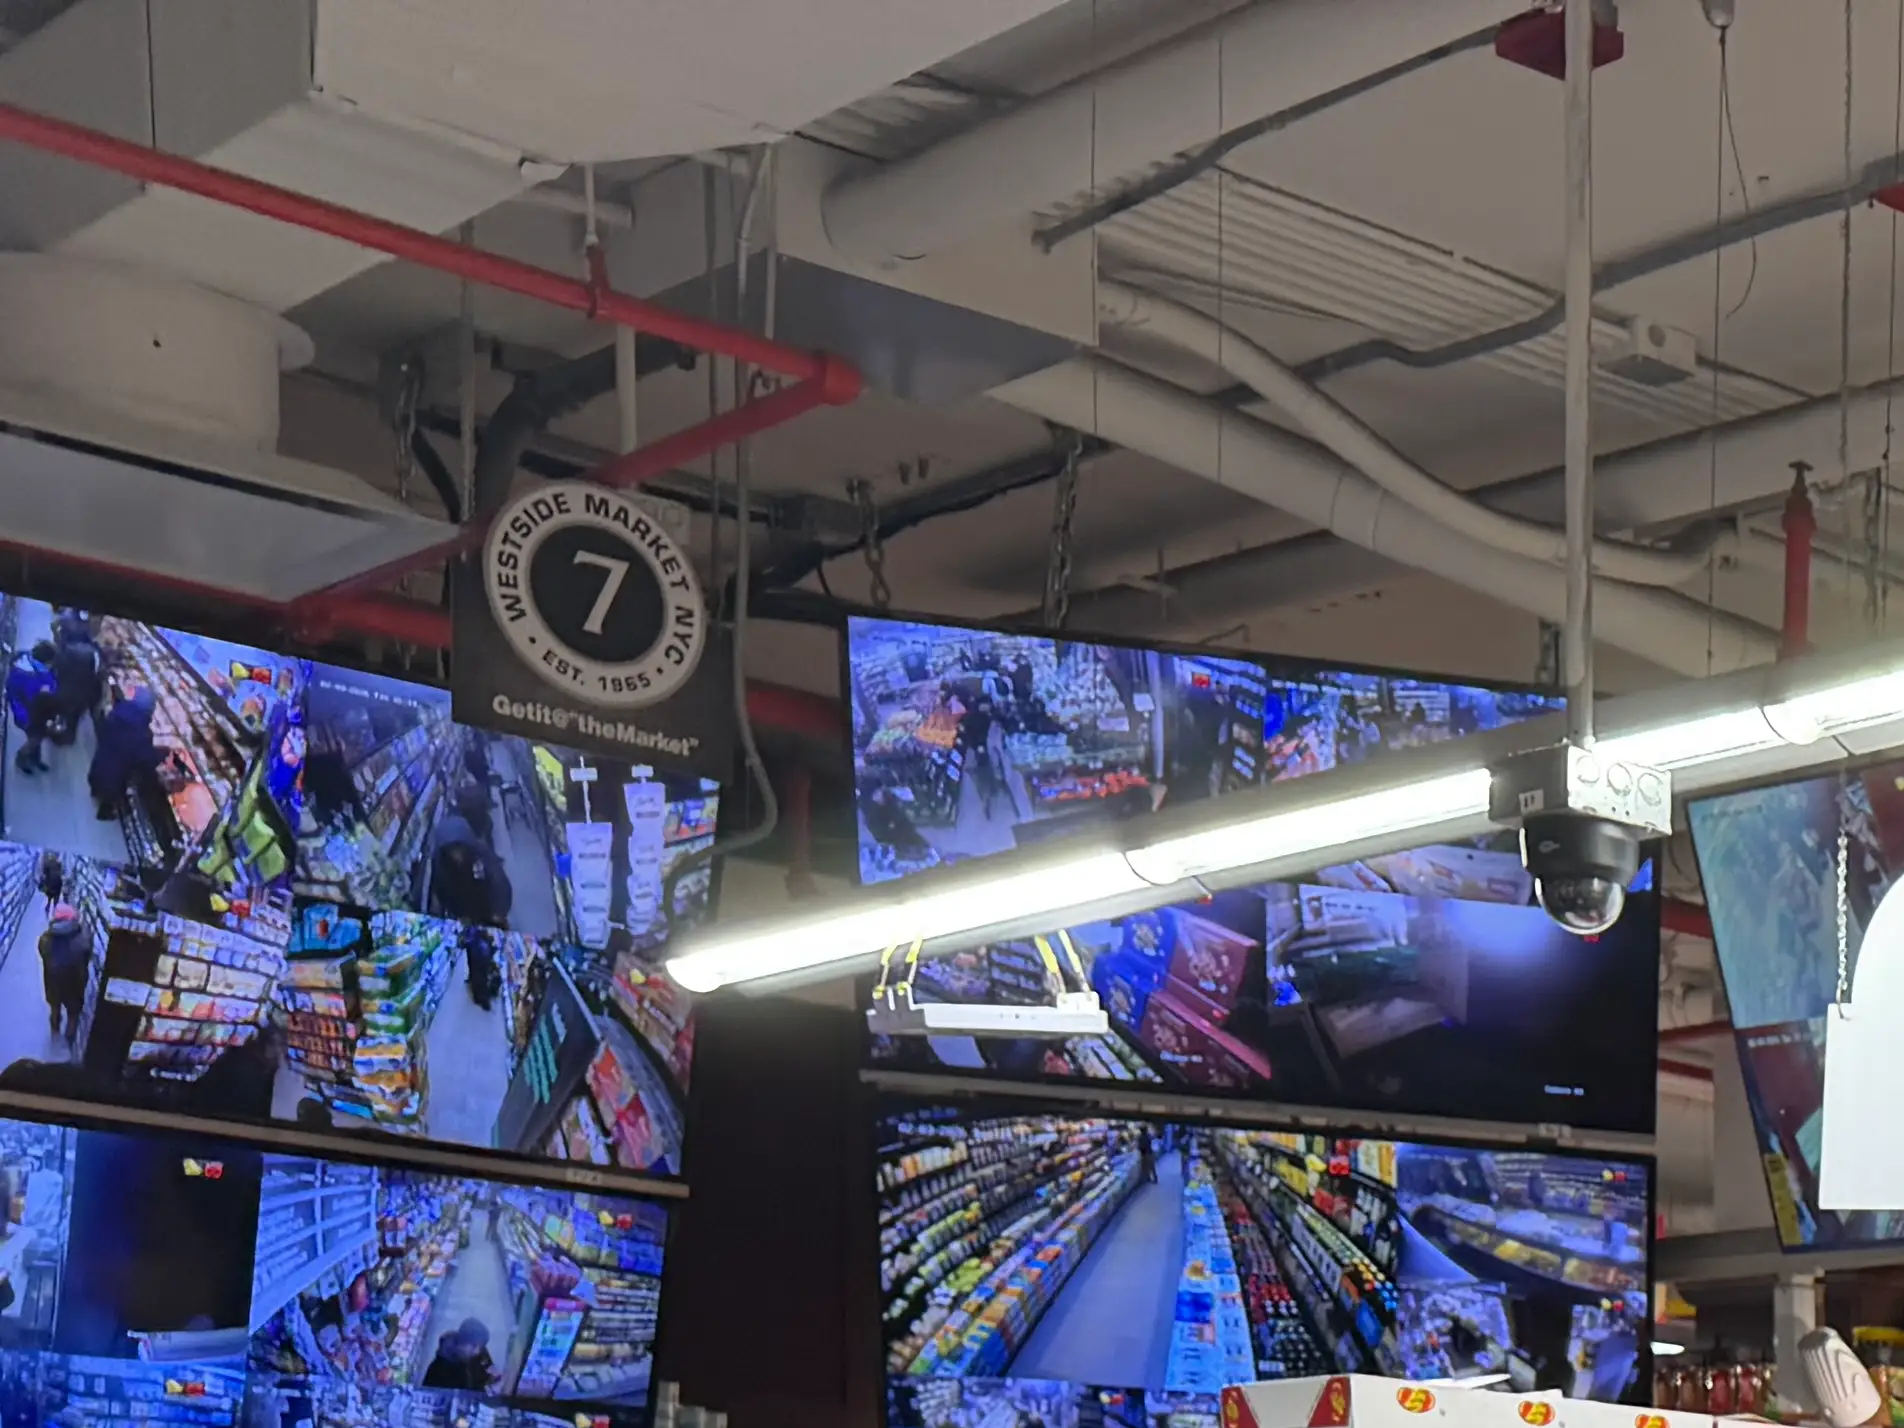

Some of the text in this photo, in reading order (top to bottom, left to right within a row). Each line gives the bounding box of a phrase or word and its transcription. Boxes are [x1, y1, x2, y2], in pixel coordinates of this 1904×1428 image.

[497, 492, 695, 667] WESTSIDE MARKET NYC
[572, 549, 630, 635] 7
[543, 649, 652, 693] EST. 1965
